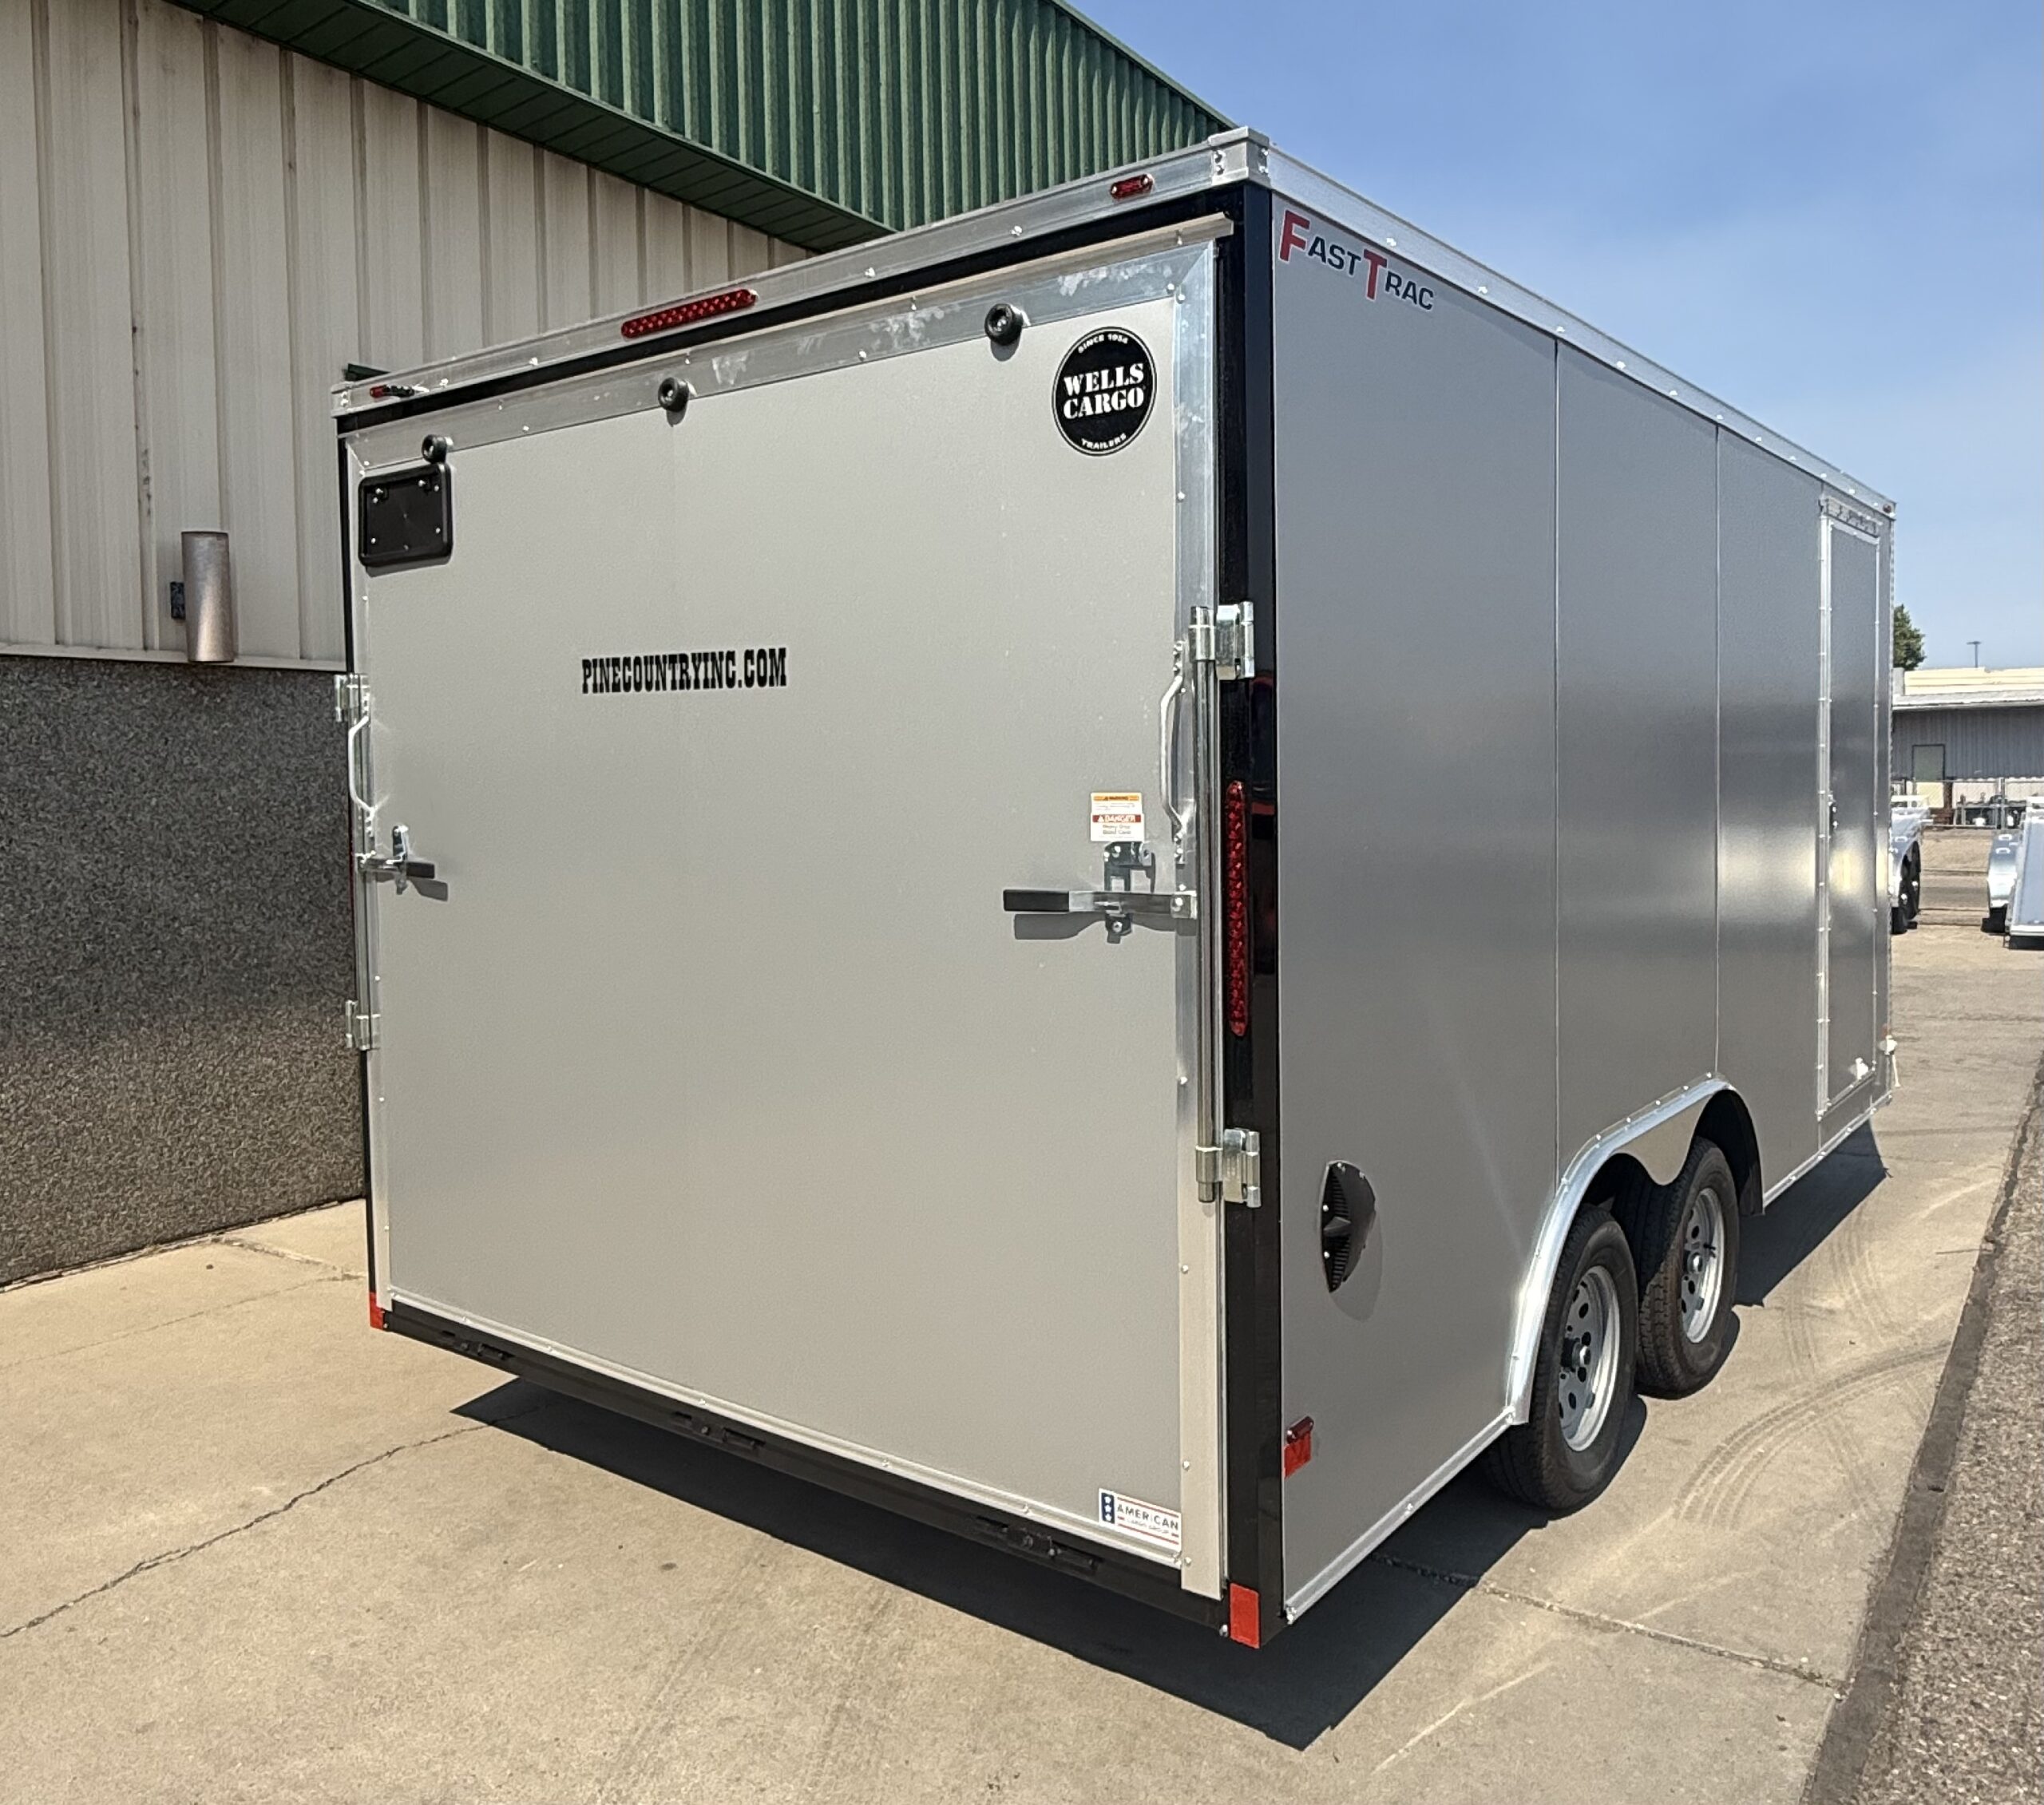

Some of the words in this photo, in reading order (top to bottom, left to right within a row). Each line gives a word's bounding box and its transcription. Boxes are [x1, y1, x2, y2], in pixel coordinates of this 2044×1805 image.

[1064, 362, 1144, 396] WELLS
[1063, 386, 1144, 419] CARGO
[1081, 433, 1127, 449] TRAILERS
[581, 647, 787, 694] PINECOUNTRYINC.COM
